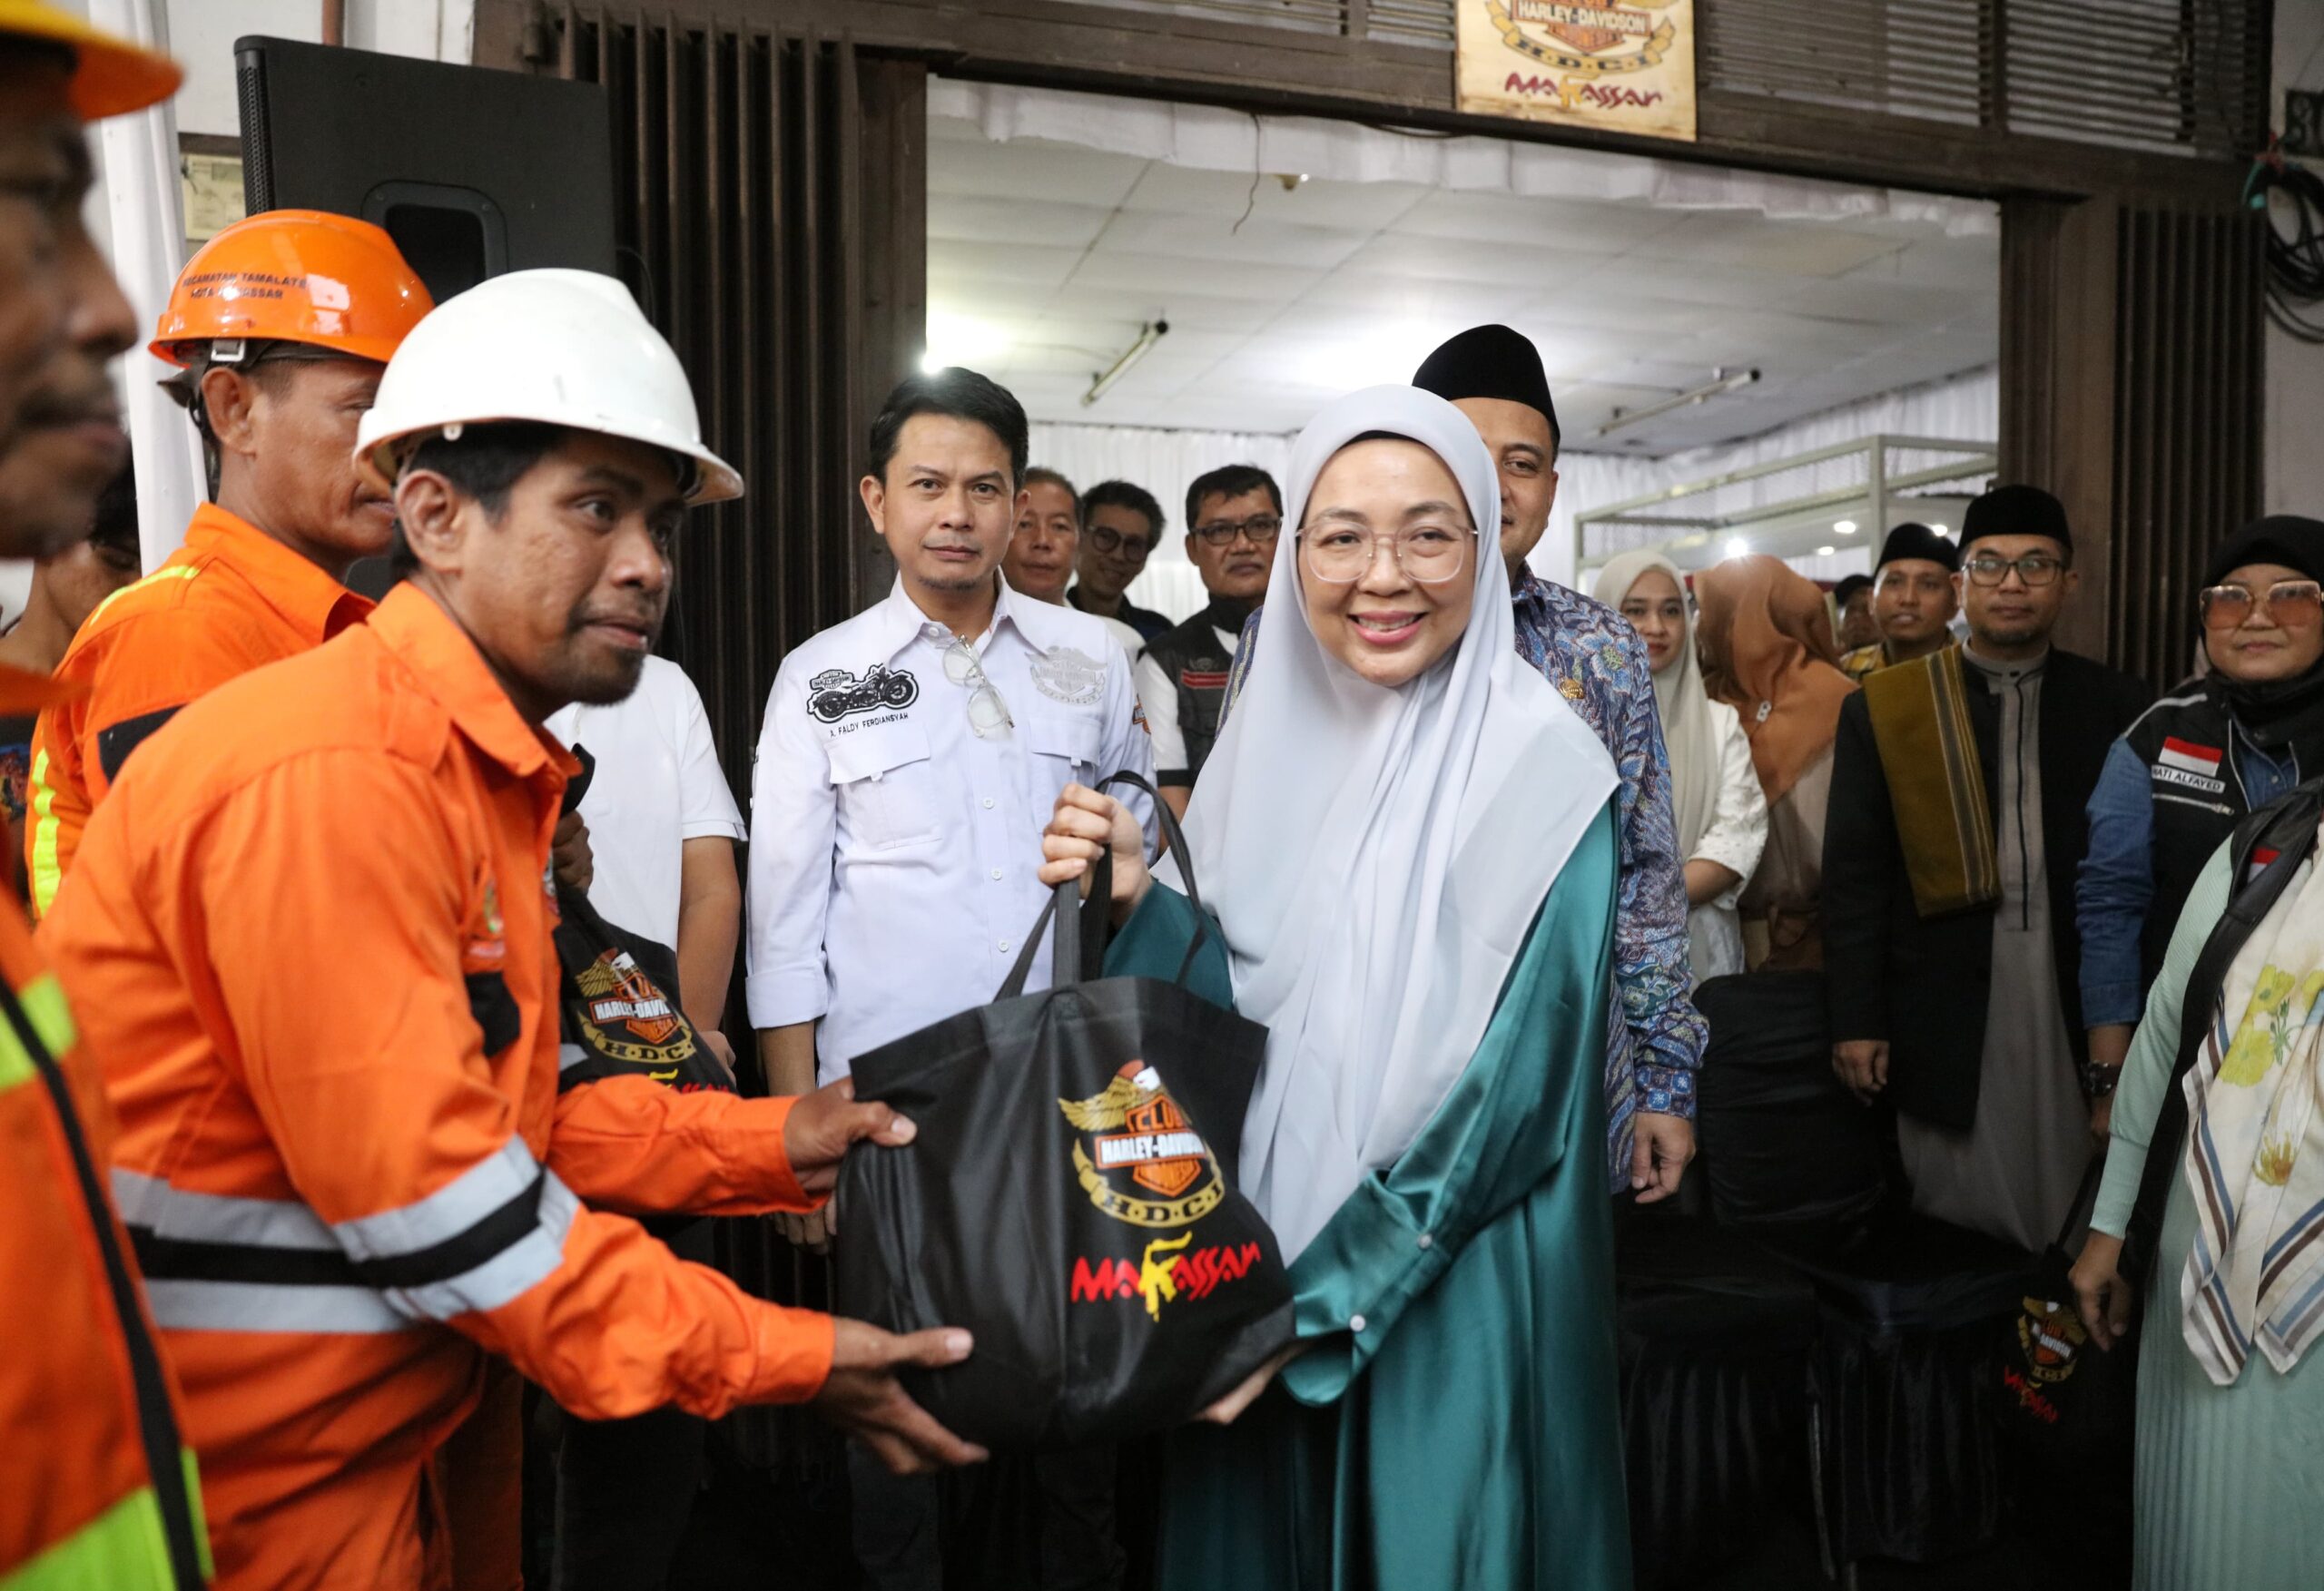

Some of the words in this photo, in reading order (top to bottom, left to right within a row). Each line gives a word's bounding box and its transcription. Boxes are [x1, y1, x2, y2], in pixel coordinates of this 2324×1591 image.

[1519, 2, 1645, 32] HARLEY-DAVIDSON
[838, 722, 859, 735] FALDY
[862, 712, 909, 728] FERDIANSYAH
[2174, 772, 2221, 790] ALFAYED
